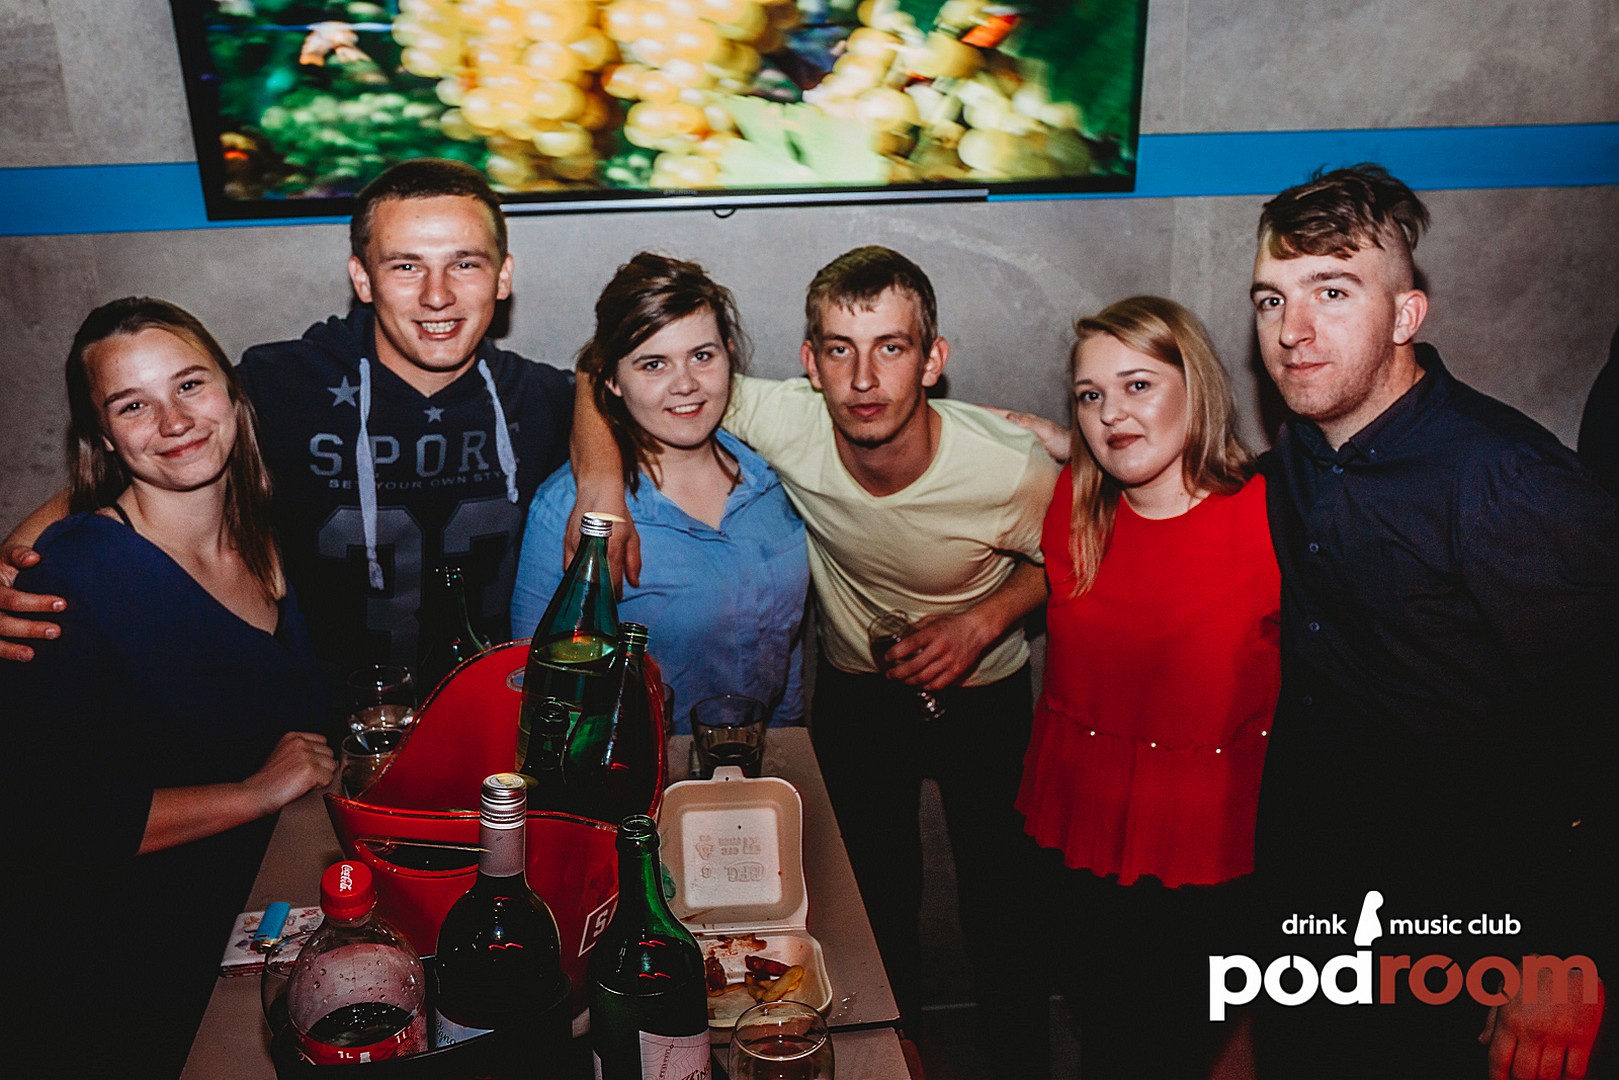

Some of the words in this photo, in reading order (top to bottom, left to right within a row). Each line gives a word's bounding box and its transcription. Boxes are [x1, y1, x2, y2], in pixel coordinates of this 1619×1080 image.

[309, 422, 520, 477] SPOR
[329, 478, 359, 490] SE
[431, 475, 467, 488] OWN
[337, 1050, 354, 1060] 1L
